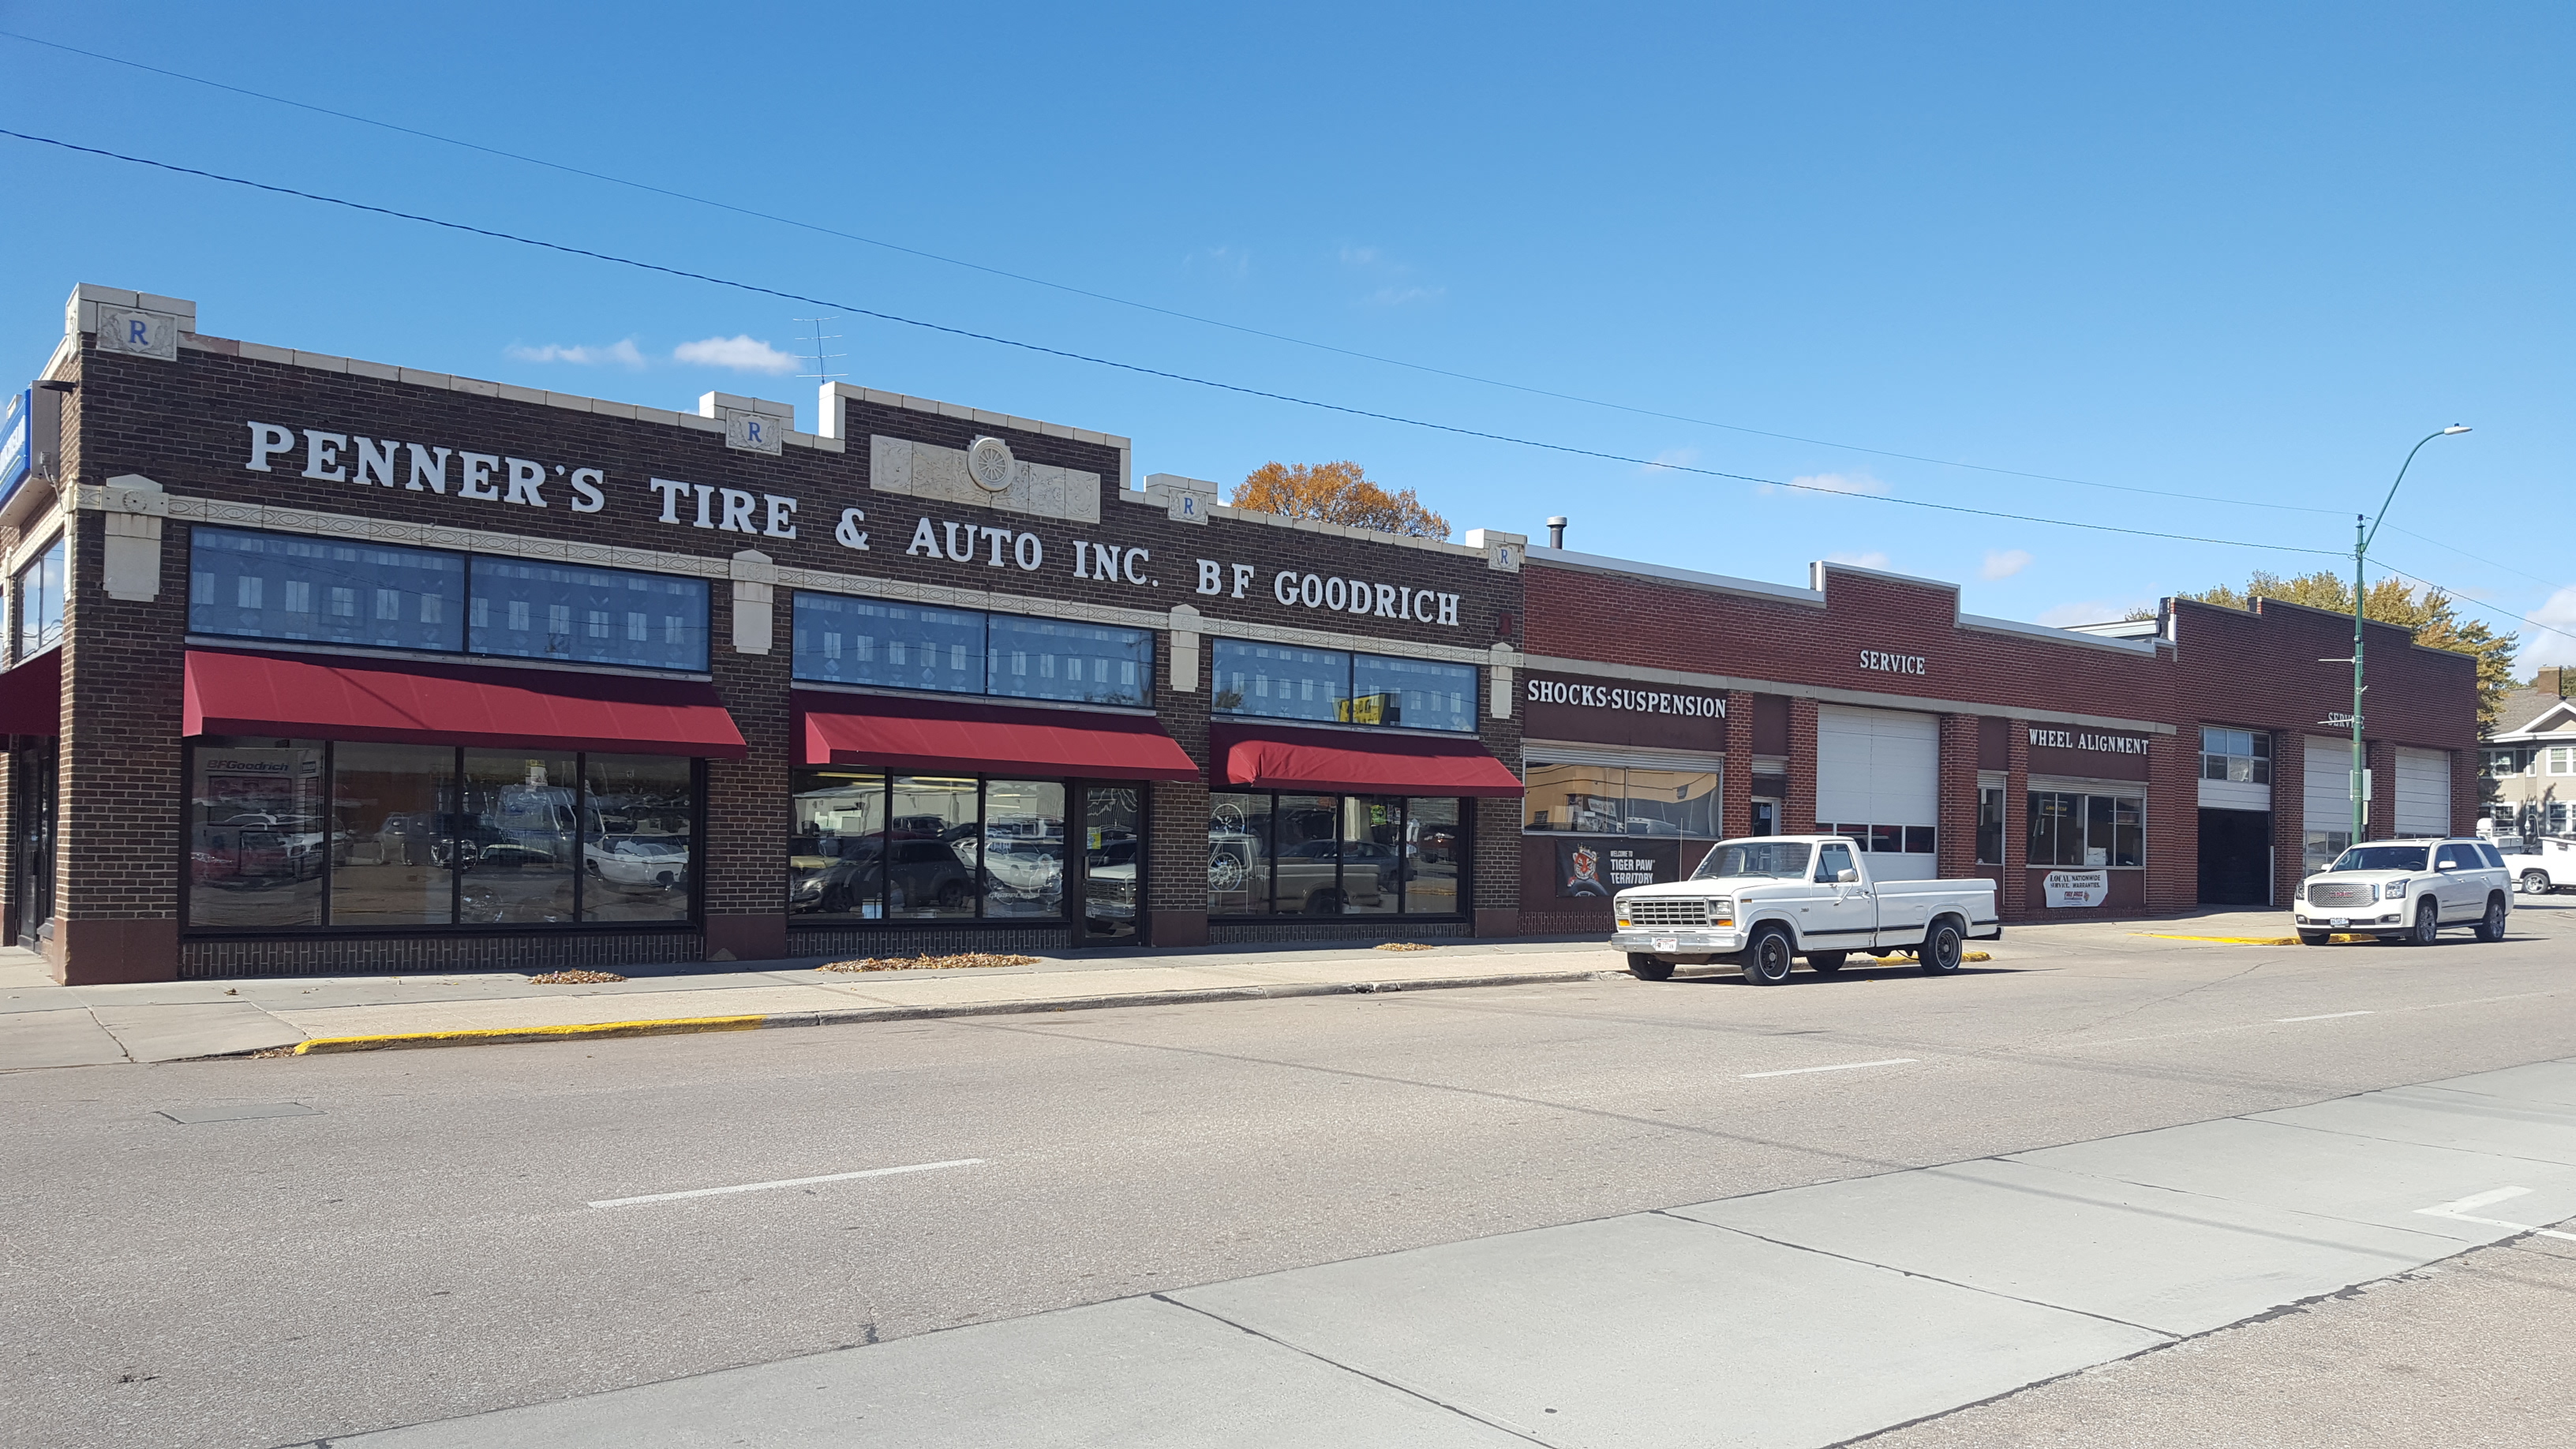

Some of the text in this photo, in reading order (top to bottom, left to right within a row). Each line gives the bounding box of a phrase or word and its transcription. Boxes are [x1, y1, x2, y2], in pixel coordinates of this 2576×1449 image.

[128, 319, 148, 346] R
[747, 421, 762, 444] R
[245, 421, 1159, 587] PENNER'S TIRE & AUTO INC.
[1183, 496, 1195, 515] R
[1500, 549, 1509, 564] R
[1196, 558, 1460, 627] BF GOODRICH
[1859, 650, 1925, 675] SERVICE
[2028, 728, 2149, 755] WHEEL ALIGNMENT
[207, 759, 289, 772] BFGoodrich
[1610, 859, 1634, 871] TIGER
[1610, 872, 1653, 884] TERRITORY
